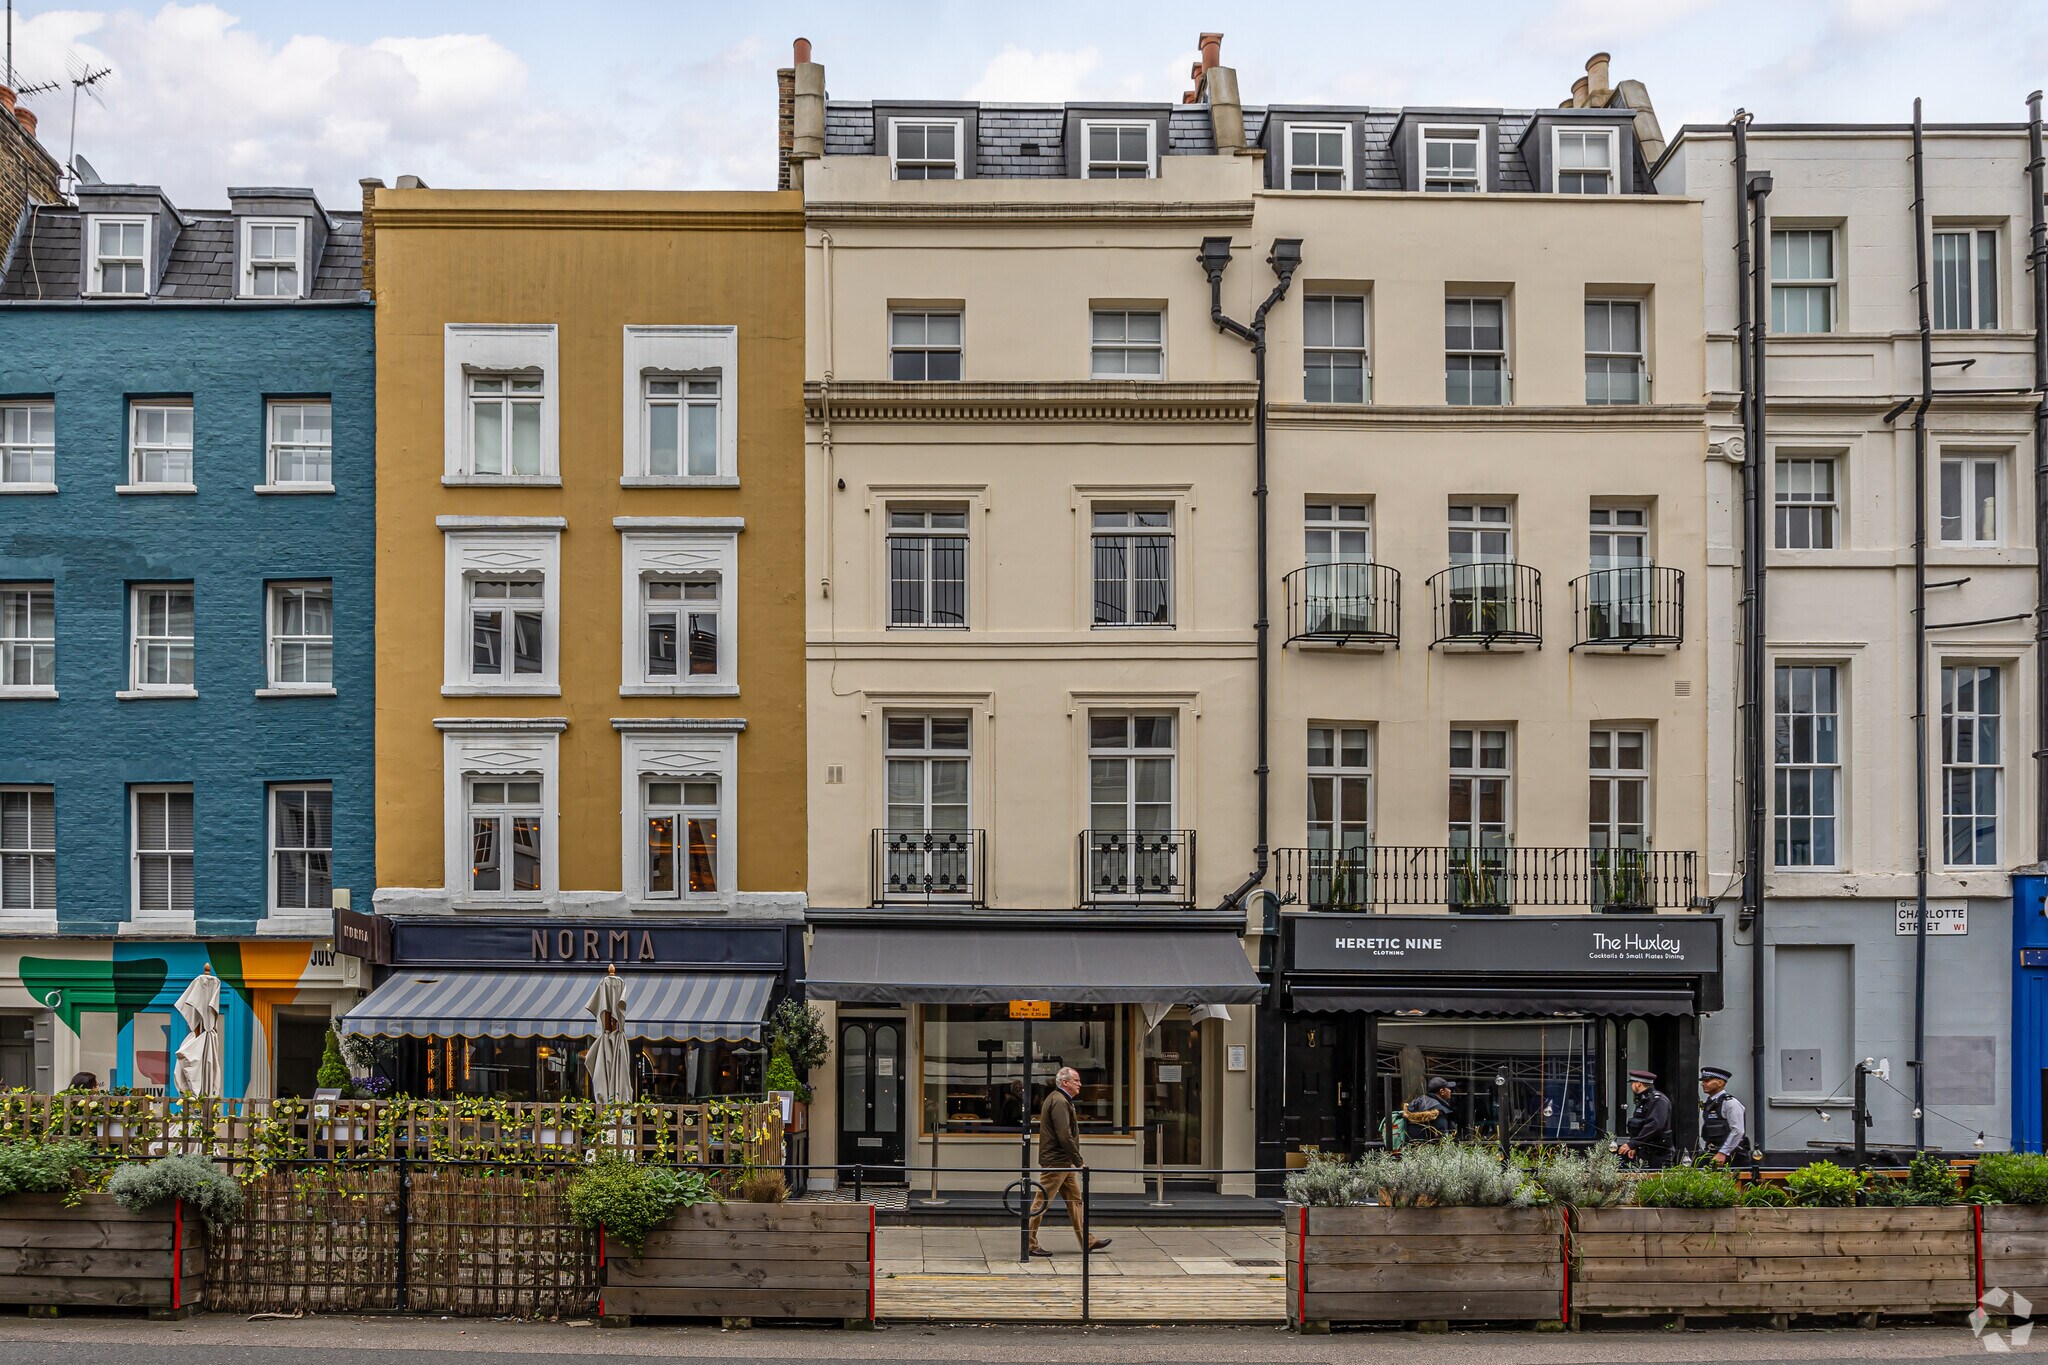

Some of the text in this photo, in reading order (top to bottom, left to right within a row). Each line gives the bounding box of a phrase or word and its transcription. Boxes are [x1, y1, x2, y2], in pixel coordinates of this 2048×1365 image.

[344, 925, 368, 942] NORMA
[1899, 922, 1940, 931] STRET
[532, 929, 655, 960] NORMA
[1336, 938, 1442, 949] HERETIC NINE
[1593, 933, 1680, 954] The Huxley
[311, 950, 336, 966] JULY
